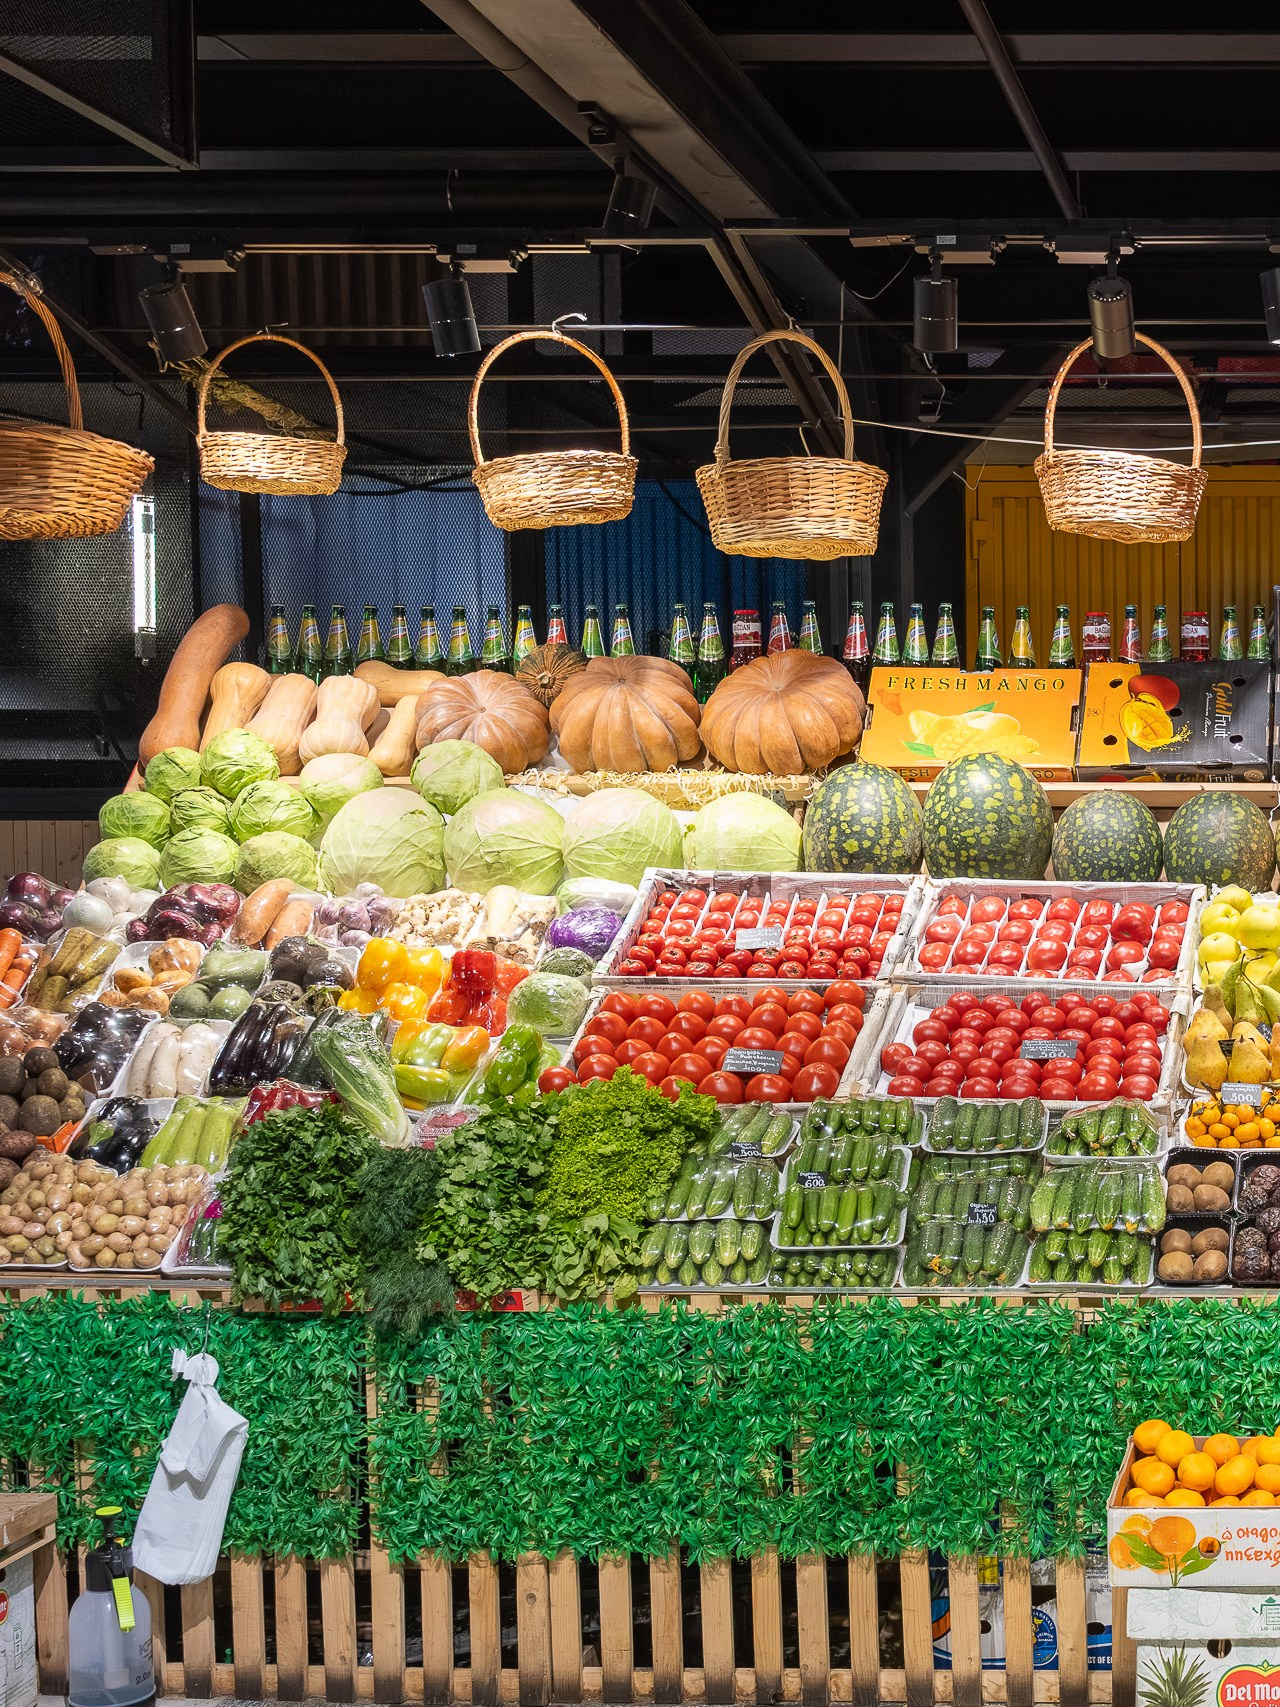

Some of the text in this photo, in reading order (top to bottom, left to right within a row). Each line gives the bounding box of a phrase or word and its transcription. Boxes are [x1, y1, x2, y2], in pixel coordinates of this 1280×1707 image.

[888, 676, 1065, 691] FRESH MANGO
[1097, 1656, 1106, 1664] OF
[1224, 1683, 1254, 1702] Del
